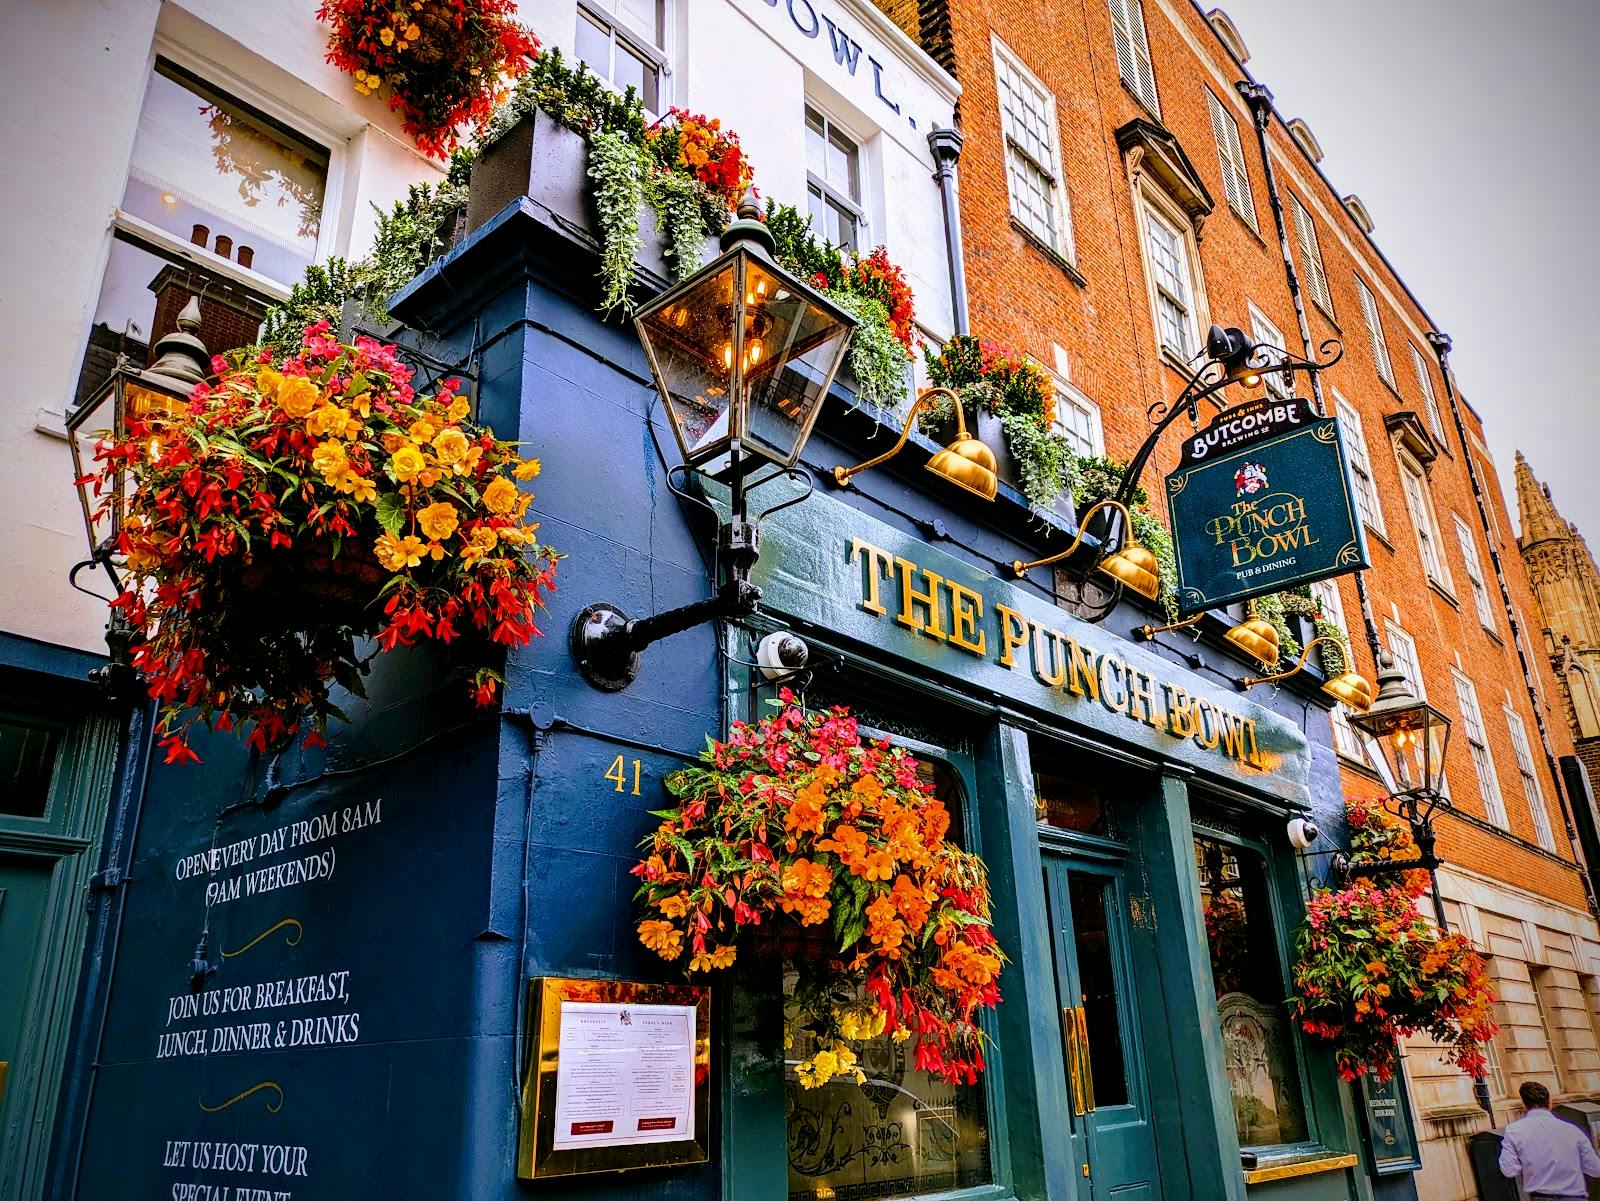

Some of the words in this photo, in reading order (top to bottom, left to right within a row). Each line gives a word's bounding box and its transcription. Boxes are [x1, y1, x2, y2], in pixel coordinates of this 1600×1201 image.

[763, 0, 917, 130] OWL.
[1191, 404, 1301, 459] BUTCOMBE
[1221, 429, 1260, 448] BREWING
[1205, 497, 1307, 546] PUNCH
[1231, 501, 1258, 516] The
[1228, 525, 1319, 568] BOWL
[1236, 567, 1254, 580] PUB
[1255, 565, 1262, 575] &
[1262, 556, 1297, 573] DINING
[852, 536, 987, 656] THE
[996, 603, 1165, 730] PUNCH
[1166, 681, 1271, 772] BOWL
[604, 754, 641, 796] 41
[176, 849, 212, 880] OPEN
[210, 837, 258, 871] EVERY
[259, 826, 289, 857] DAY
[290, 811, 338, 848] FROM
[342, 798, 382, 833] 8AM
[205, 875, 242, 907] (9AM
[245, 847, 336, 897] WEEKENDS)
[166, 993, 200, 1027] JOIN
[202, 989, 221, 1016] US
[221, 985, 252, 1013] FOR
[254, 970, 350, 1009] BREAKFAST,
[156, 1029, 207, 1058] LUNCH,
[211, 1023, 271, 1053] DINNER
[274, 1021, 287, 1047] &
[289, 1013, 359, 1046] DRINKS
[163, 1141, 191, 1167] LET
[192, 1142, 212, 1169] US
[212, 1143, 259, 1172] HOST
[262, 1145, 308, 1177] YOUR
